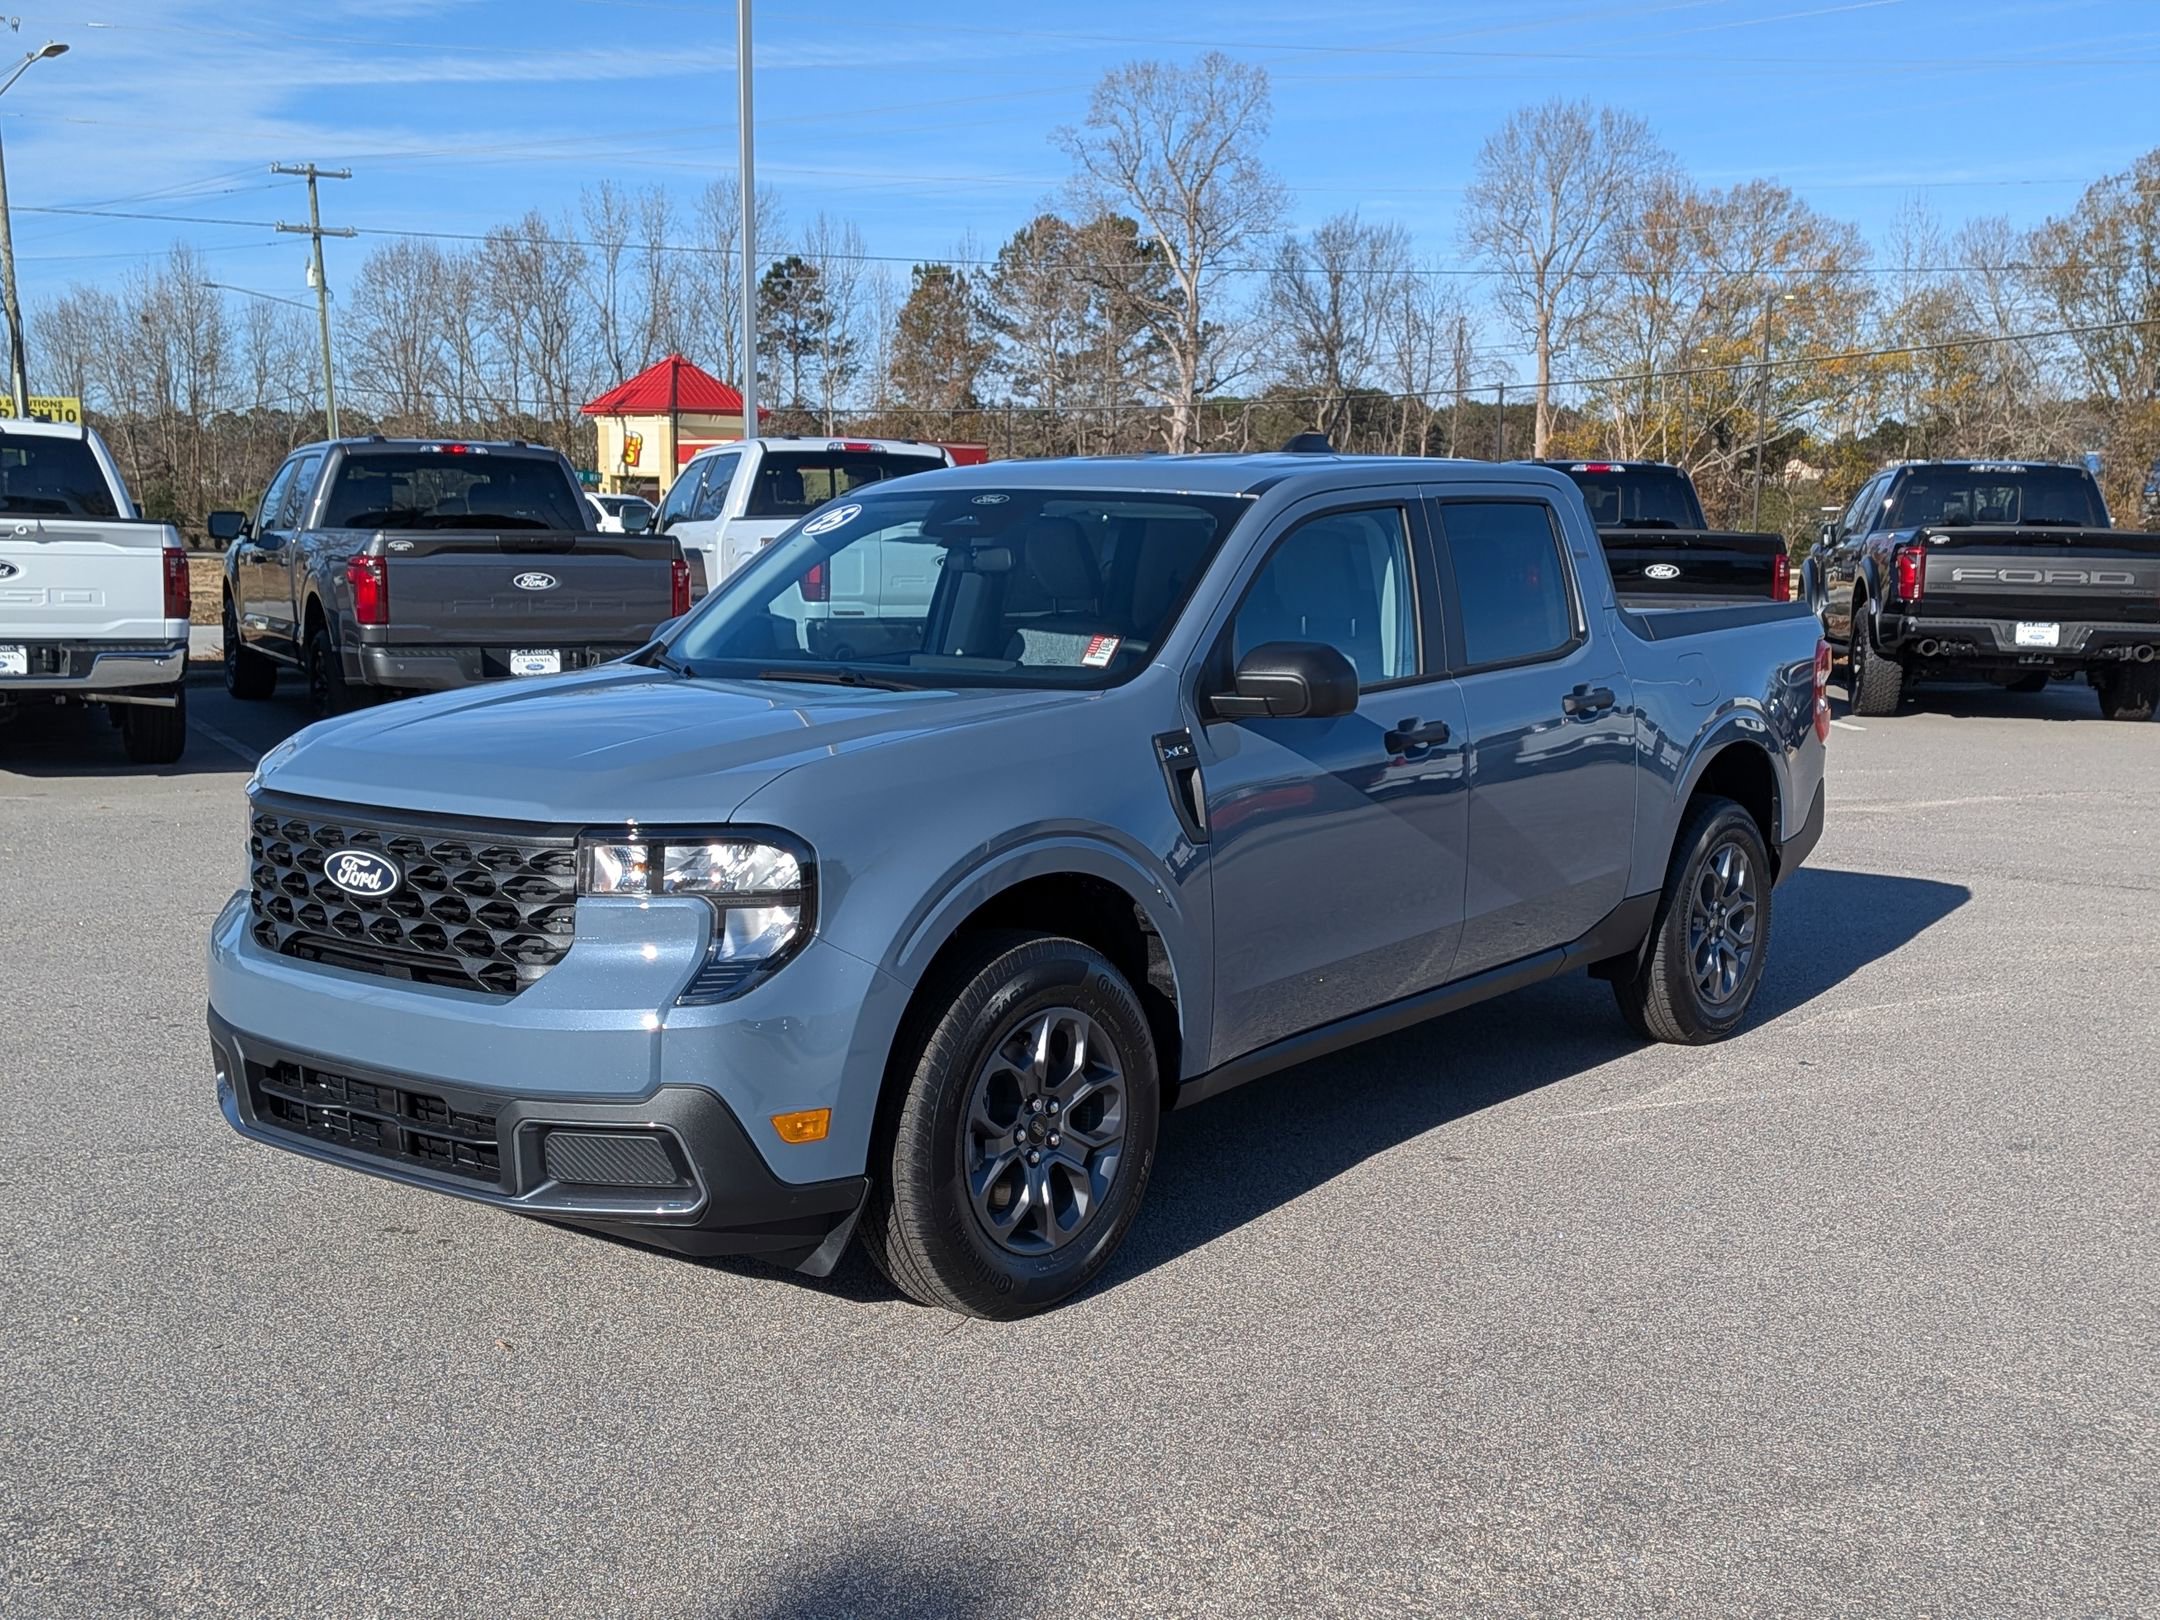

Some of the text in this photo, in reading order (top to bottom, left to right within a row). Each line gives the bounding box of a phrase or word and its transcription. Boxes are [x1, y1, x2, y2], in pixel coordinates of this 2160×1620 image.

[521, 574, 548, 587] Ford
[1952, 567, 2135, 585] FORD
[337, 855, 383, 890] Ford
